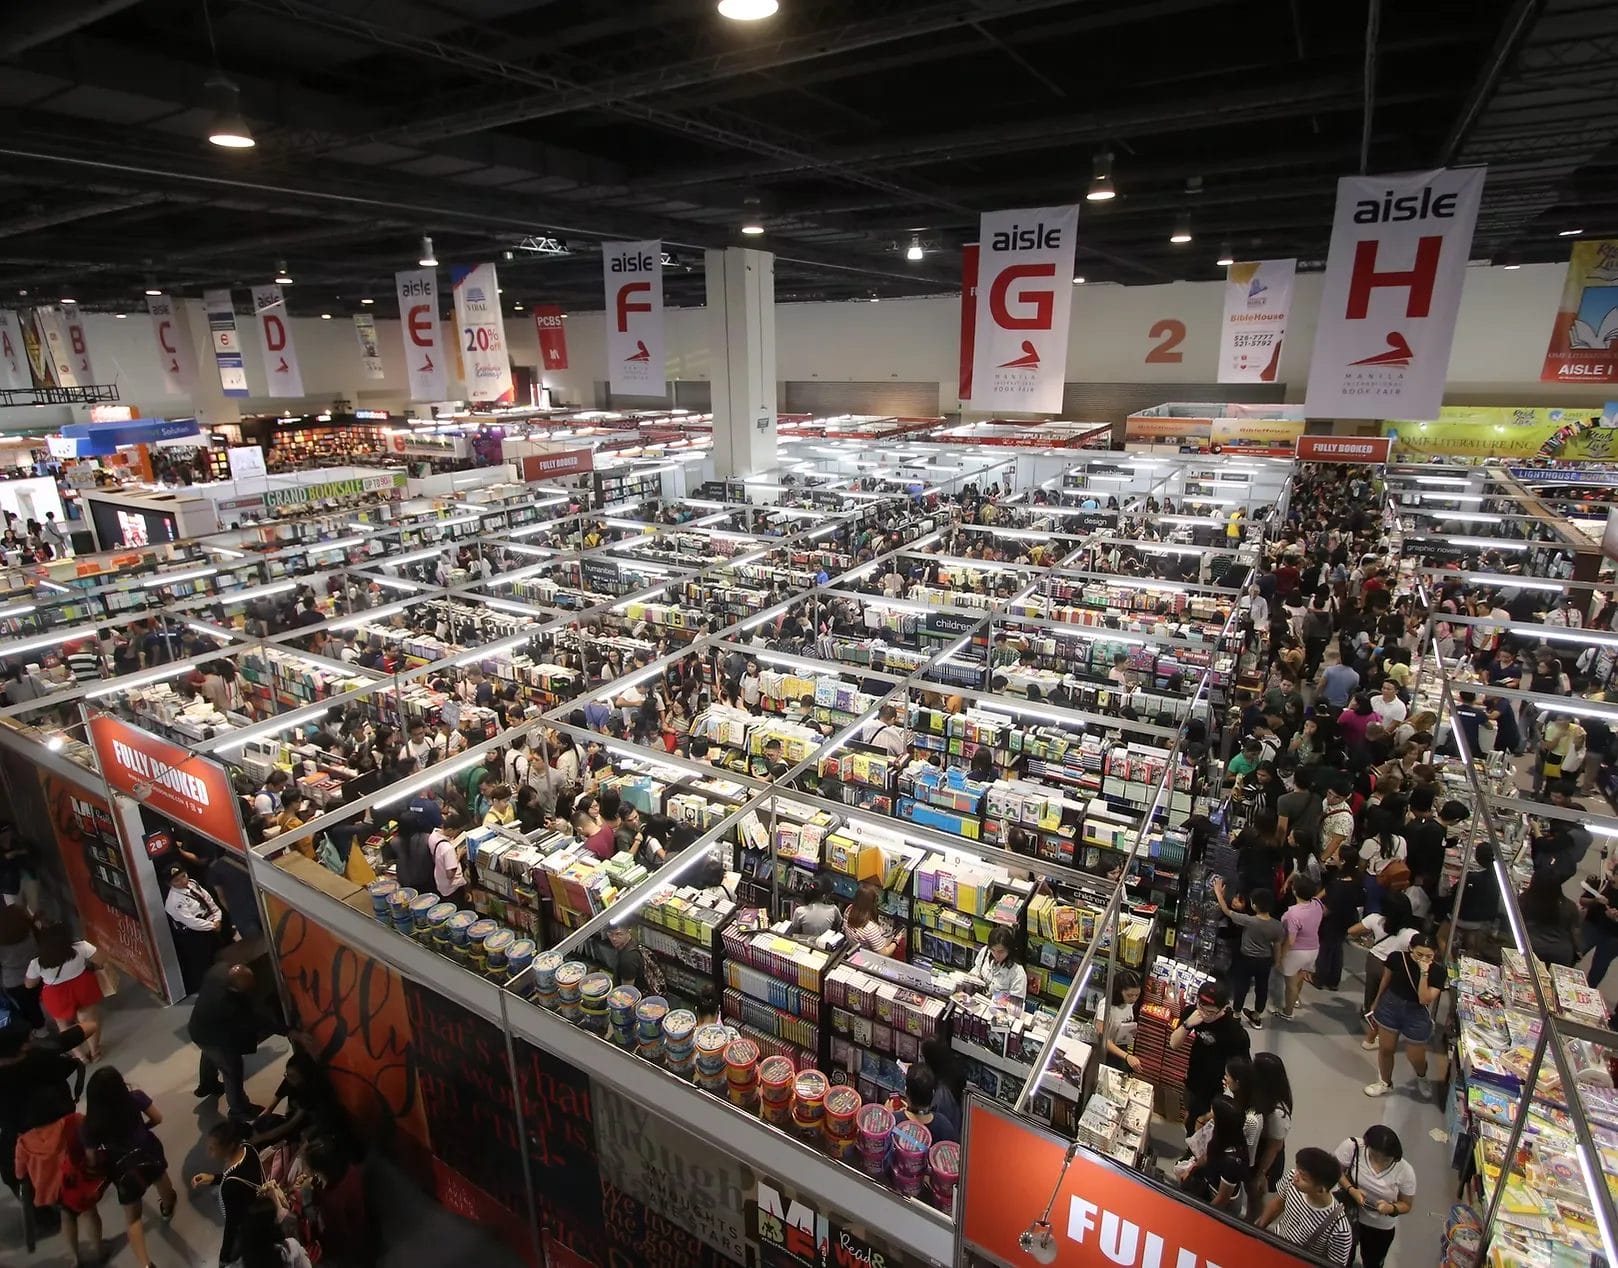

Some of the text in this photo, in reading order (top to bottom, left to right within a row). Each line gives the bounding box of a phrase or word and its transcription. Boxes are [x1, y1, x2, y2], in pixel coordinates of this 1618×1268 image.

[1353, 187, 1458, 224] aisle
[992, 223, 1061, 251] aisle
[611, 252, 652, 272] aisle
[402, 280, 431, 297] aisle
[1345, 236, 1443, 319] H
[617, 282, 651, 332] F
[990, 263, 1056, 330] G
[408, 304, 433, 347] E
[537, 316, 561, 327] PCBS
[1230, 312, 1285, 323] BibleHouse
[2, 330, 15, 357] A
[69, 325, 85, 354] B
[159, 320, 176, 353] C
[263, 315, 286, 351] D
[1145, 319, 1186, 364] 2
[1558, 364, 1613, 375] AISLE I
[1312, 443, 1373, 453] FULLY BOOKED
[1519, 470, 1577, 480] LIGHTHOUSE
[267, 487, 307, 507] GRAND
[308, 479, 363, 501] BOOKSALE
[364, 479, 373, 492] UP
[373, 478, 380, 490] TO
[1084, 516, 1107, 526] design
[1407, 544, 1435, 553] graphic
[112, 739, 151, 778] FULLY
[150, 757, 210, 806] BOOKED
[840, 1230, 872, 1265] Read
